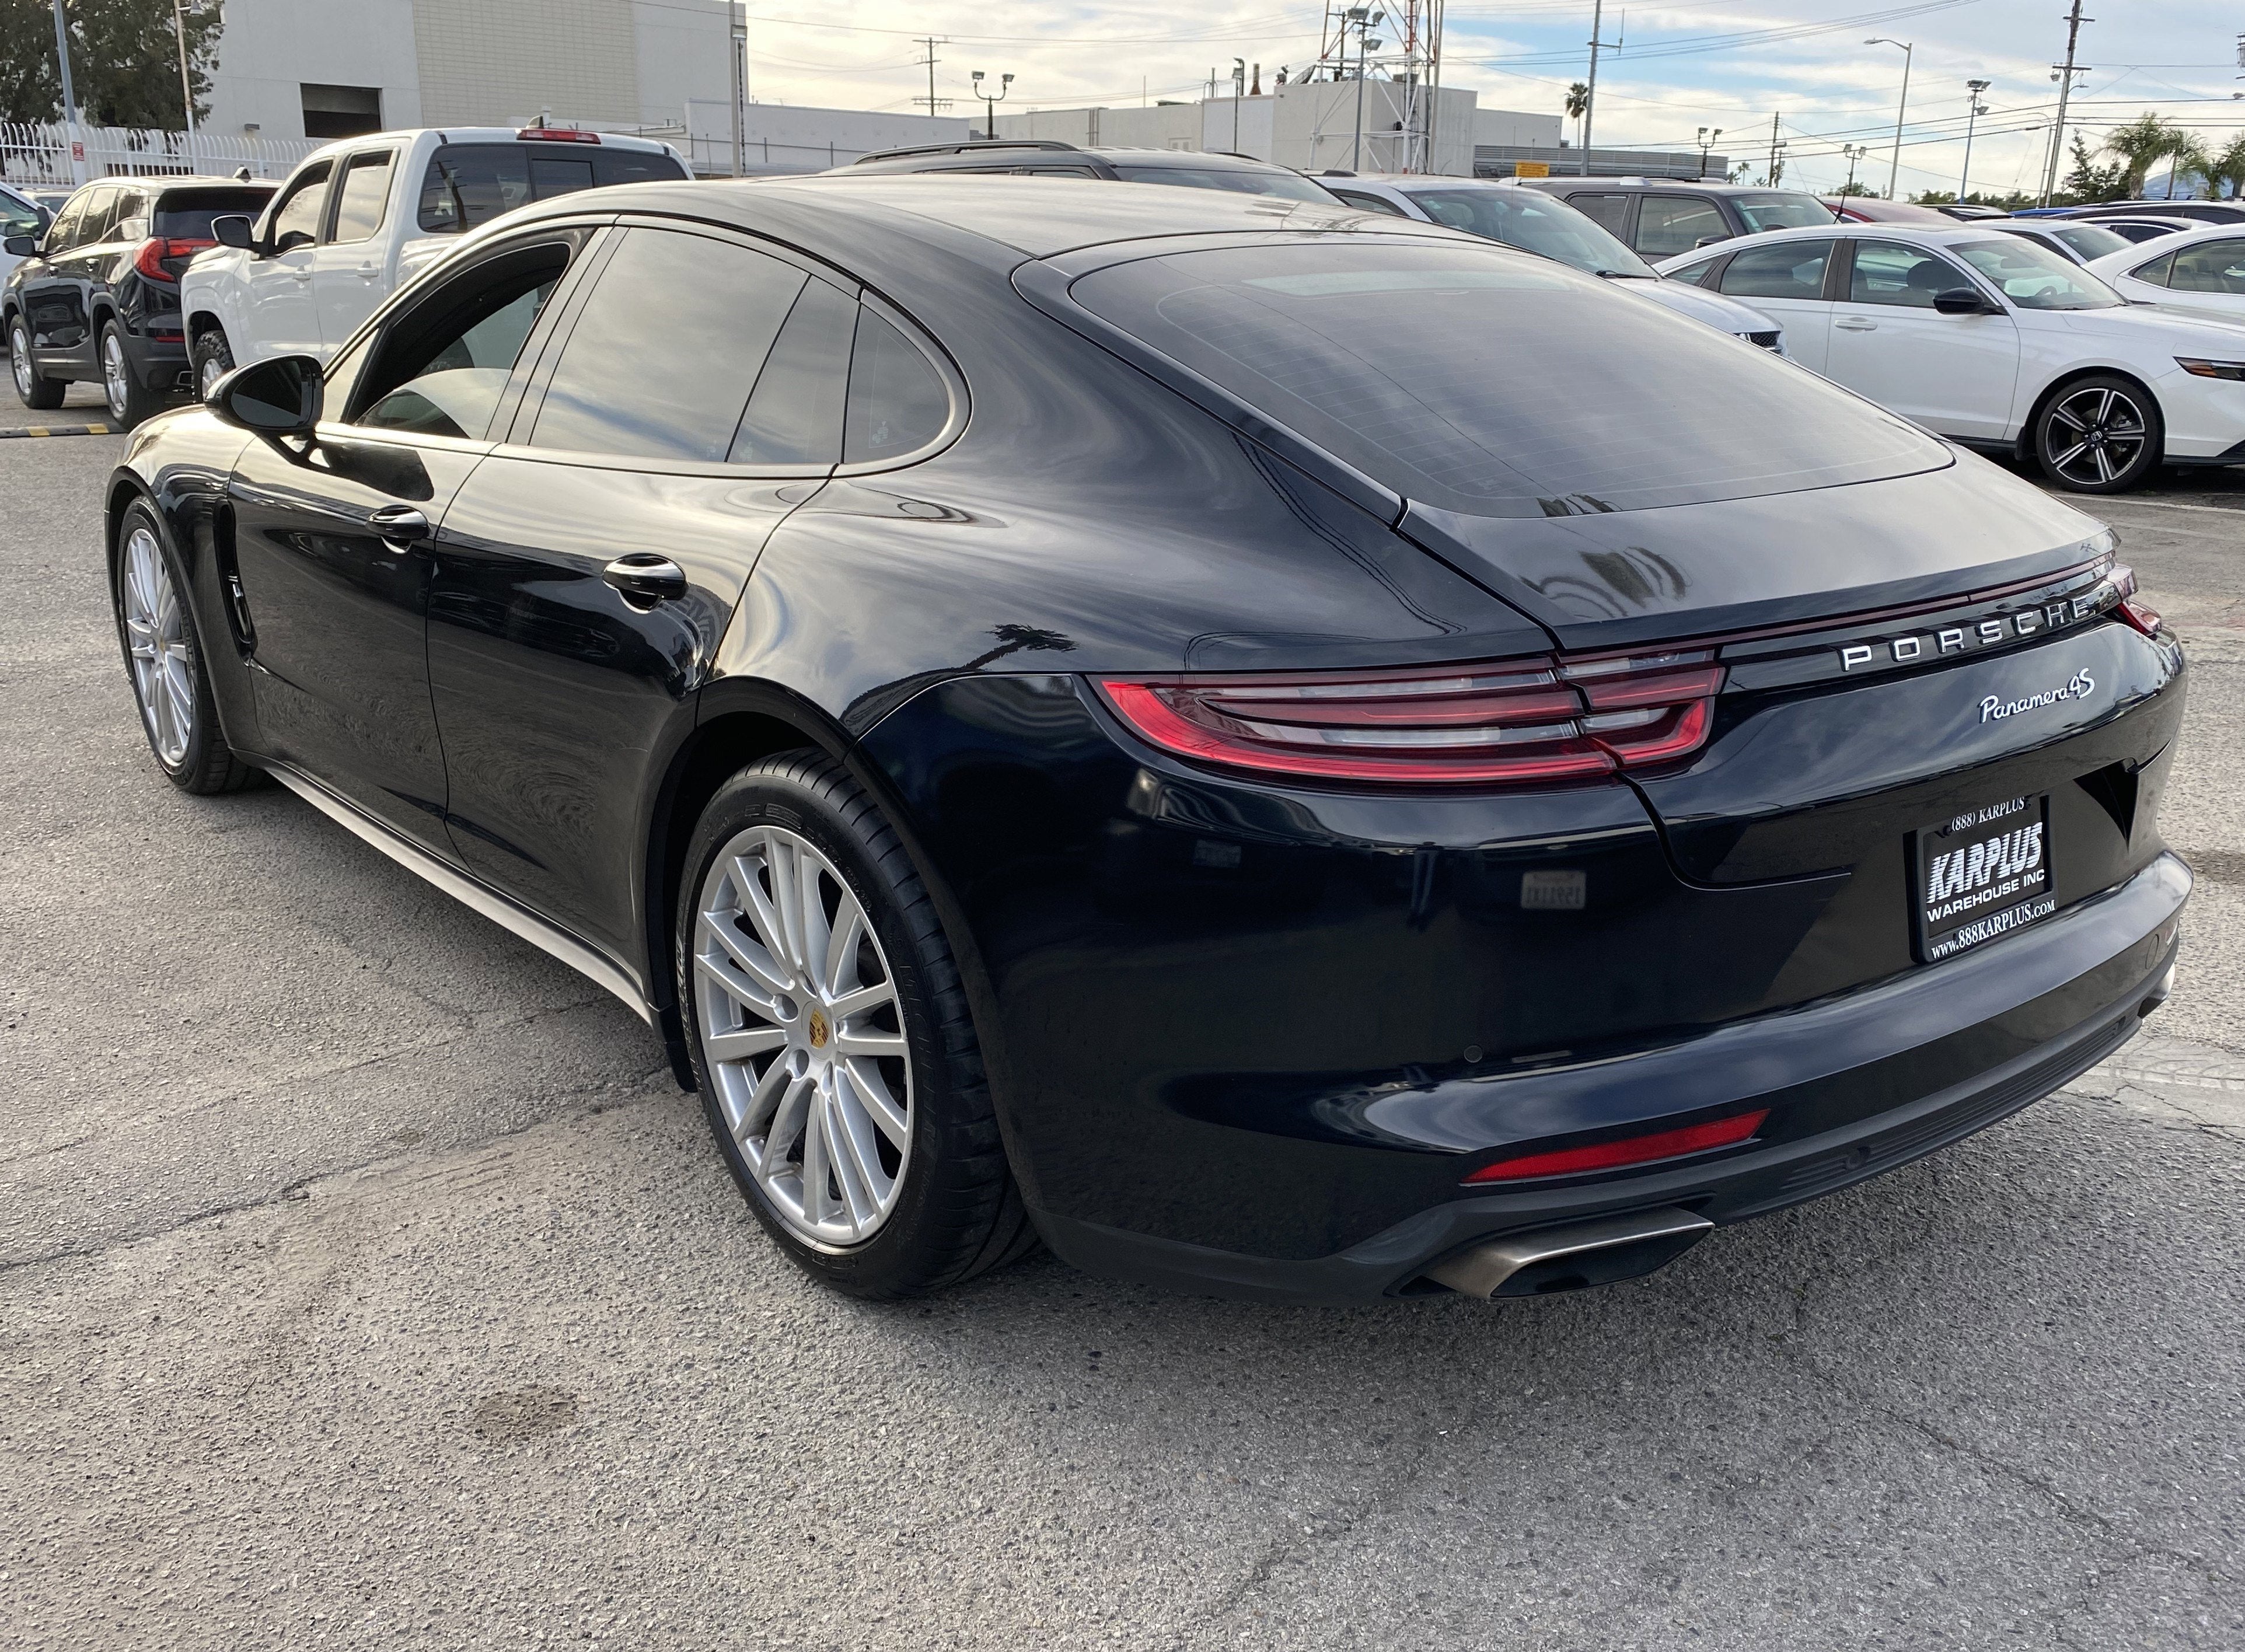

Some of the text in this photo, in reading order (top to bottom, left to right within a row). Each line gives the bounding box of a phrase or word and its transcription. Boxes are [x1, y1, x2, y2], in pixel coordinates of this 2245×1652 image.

[1839, 597, 2090, 672] PORSCHE
[1951, 796, 2026, 832] (888) KARPLUS
[1926, 821, 2043, 904] KARPLUS
[1926, 868, 2045, 923] WAREHOUSE INC
